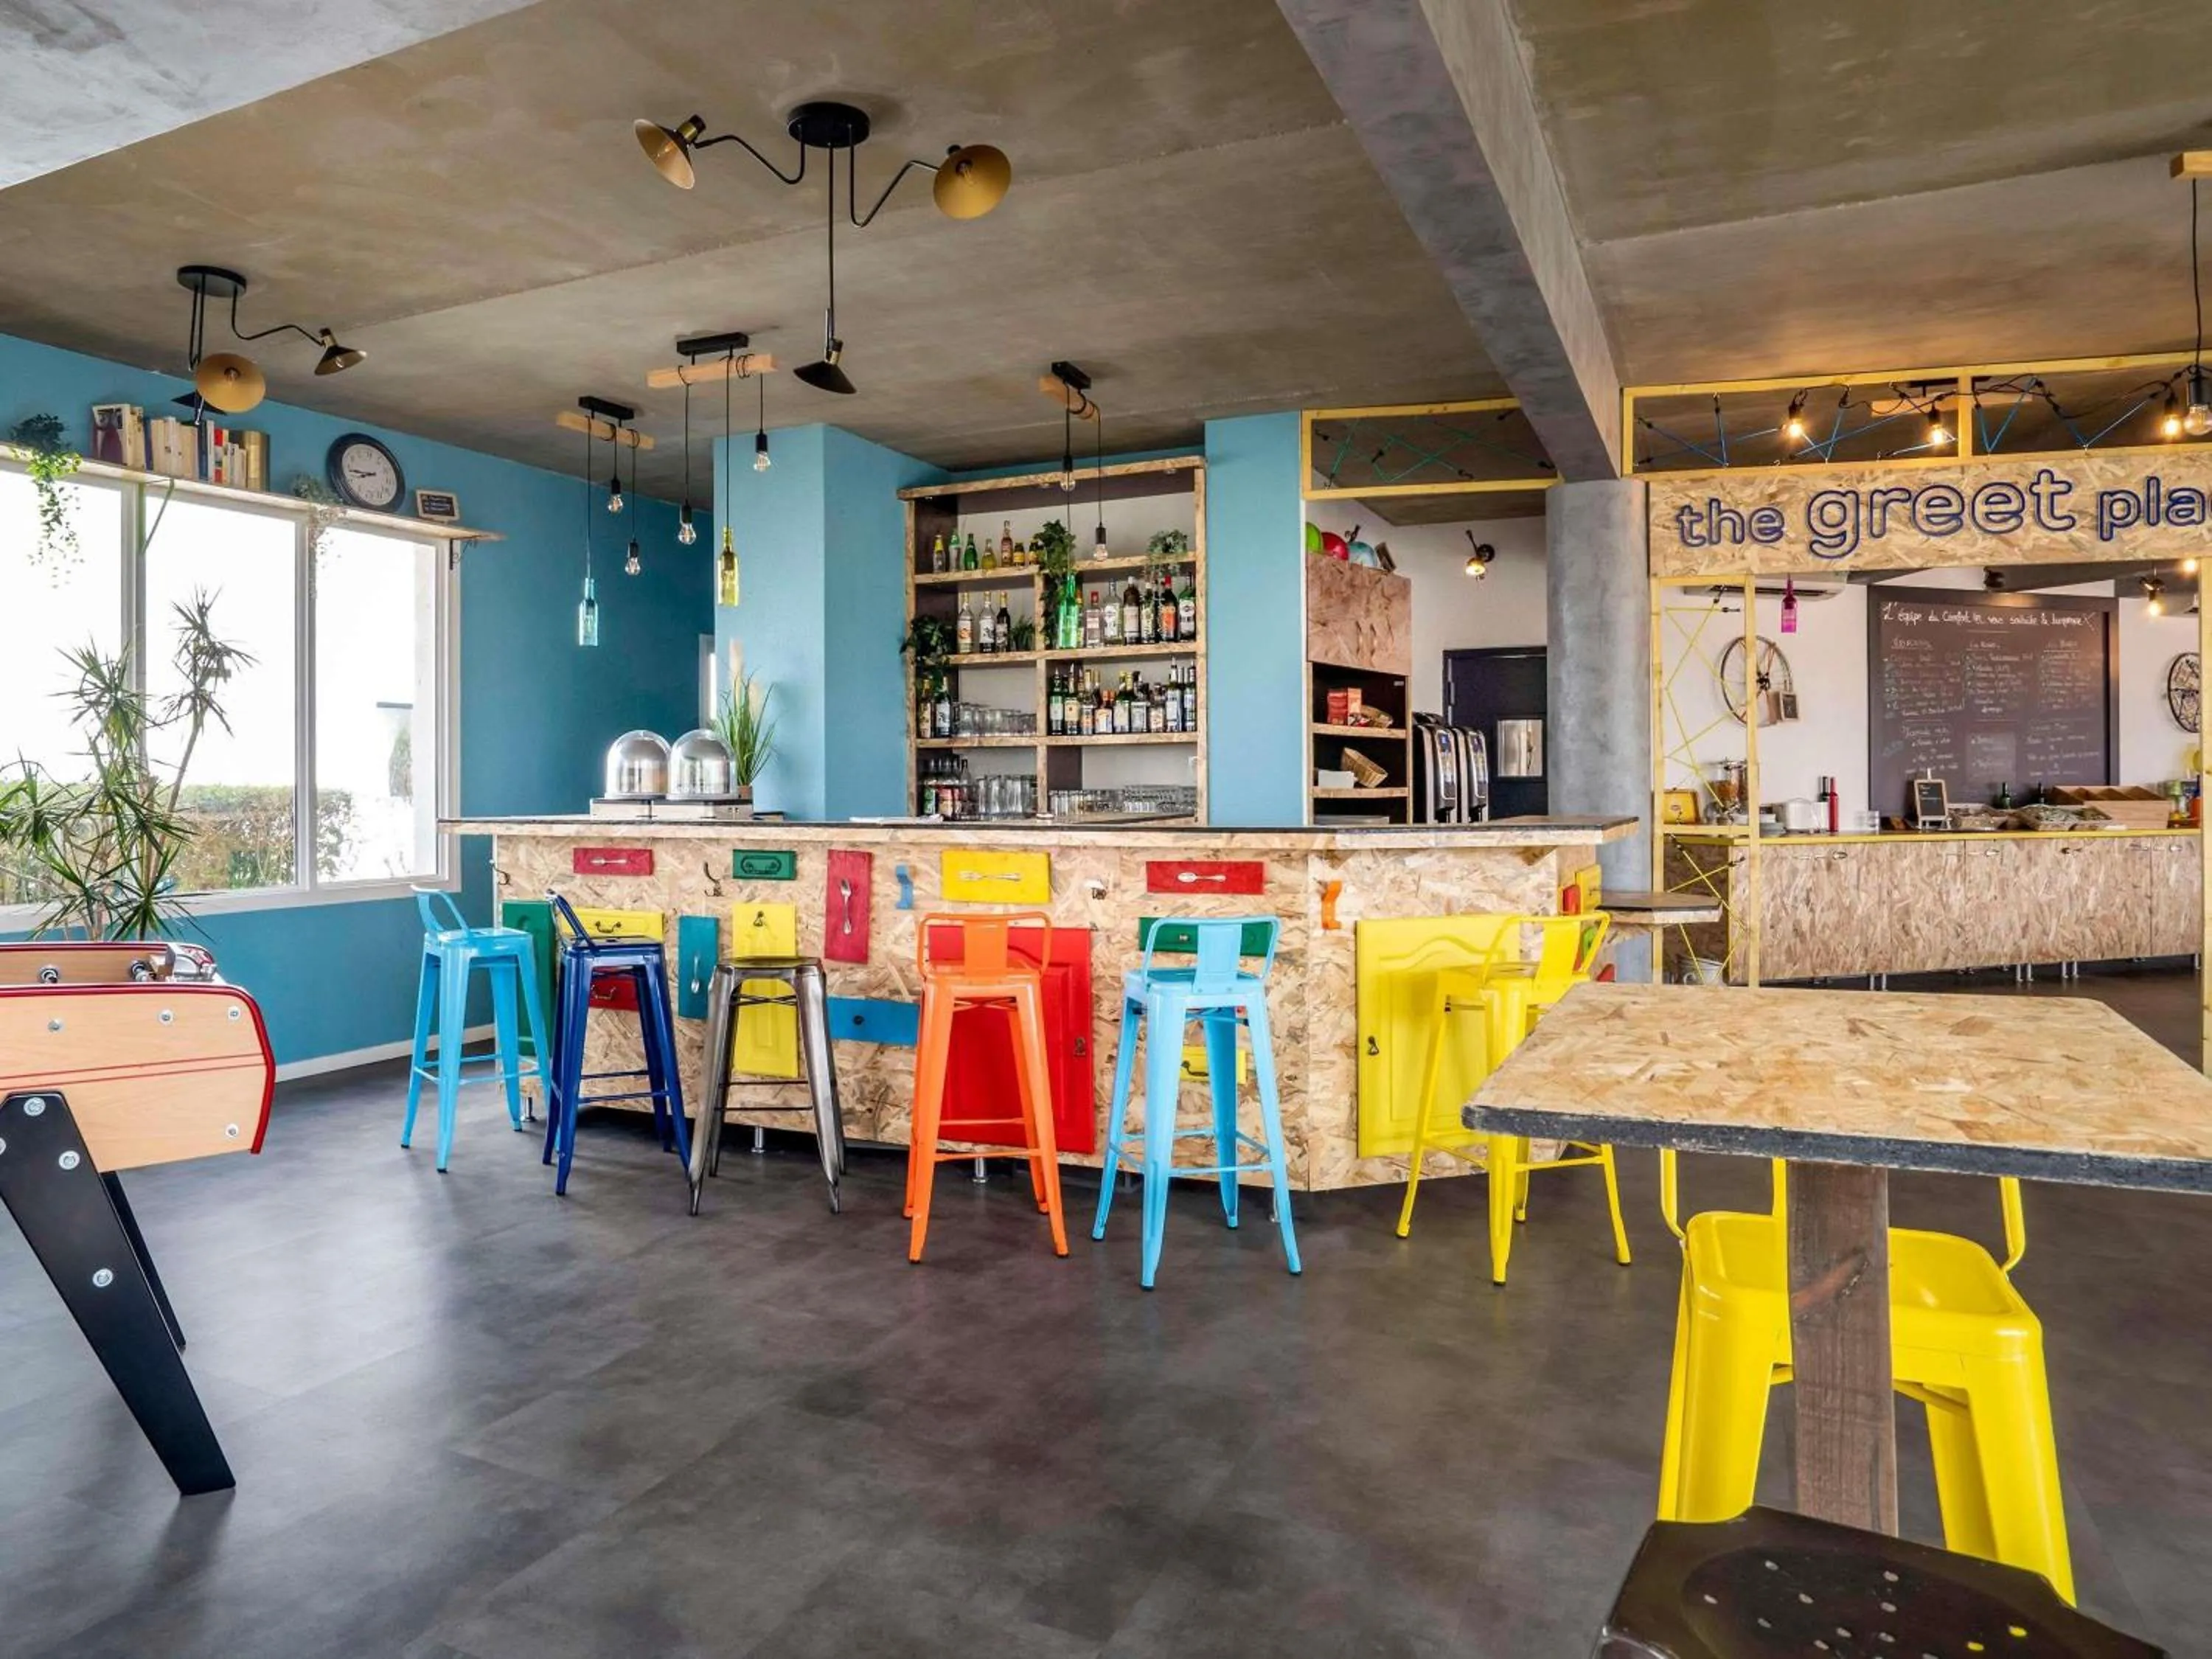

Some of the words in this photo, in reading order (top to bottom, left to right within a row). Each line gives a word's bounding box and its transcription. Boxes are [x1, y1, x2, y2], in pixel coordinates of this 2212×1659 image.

[1675, 498, 1785, 547] the
[1807, 468, 2076, 559] greet
[2098, 476, 2212, 542] pla
